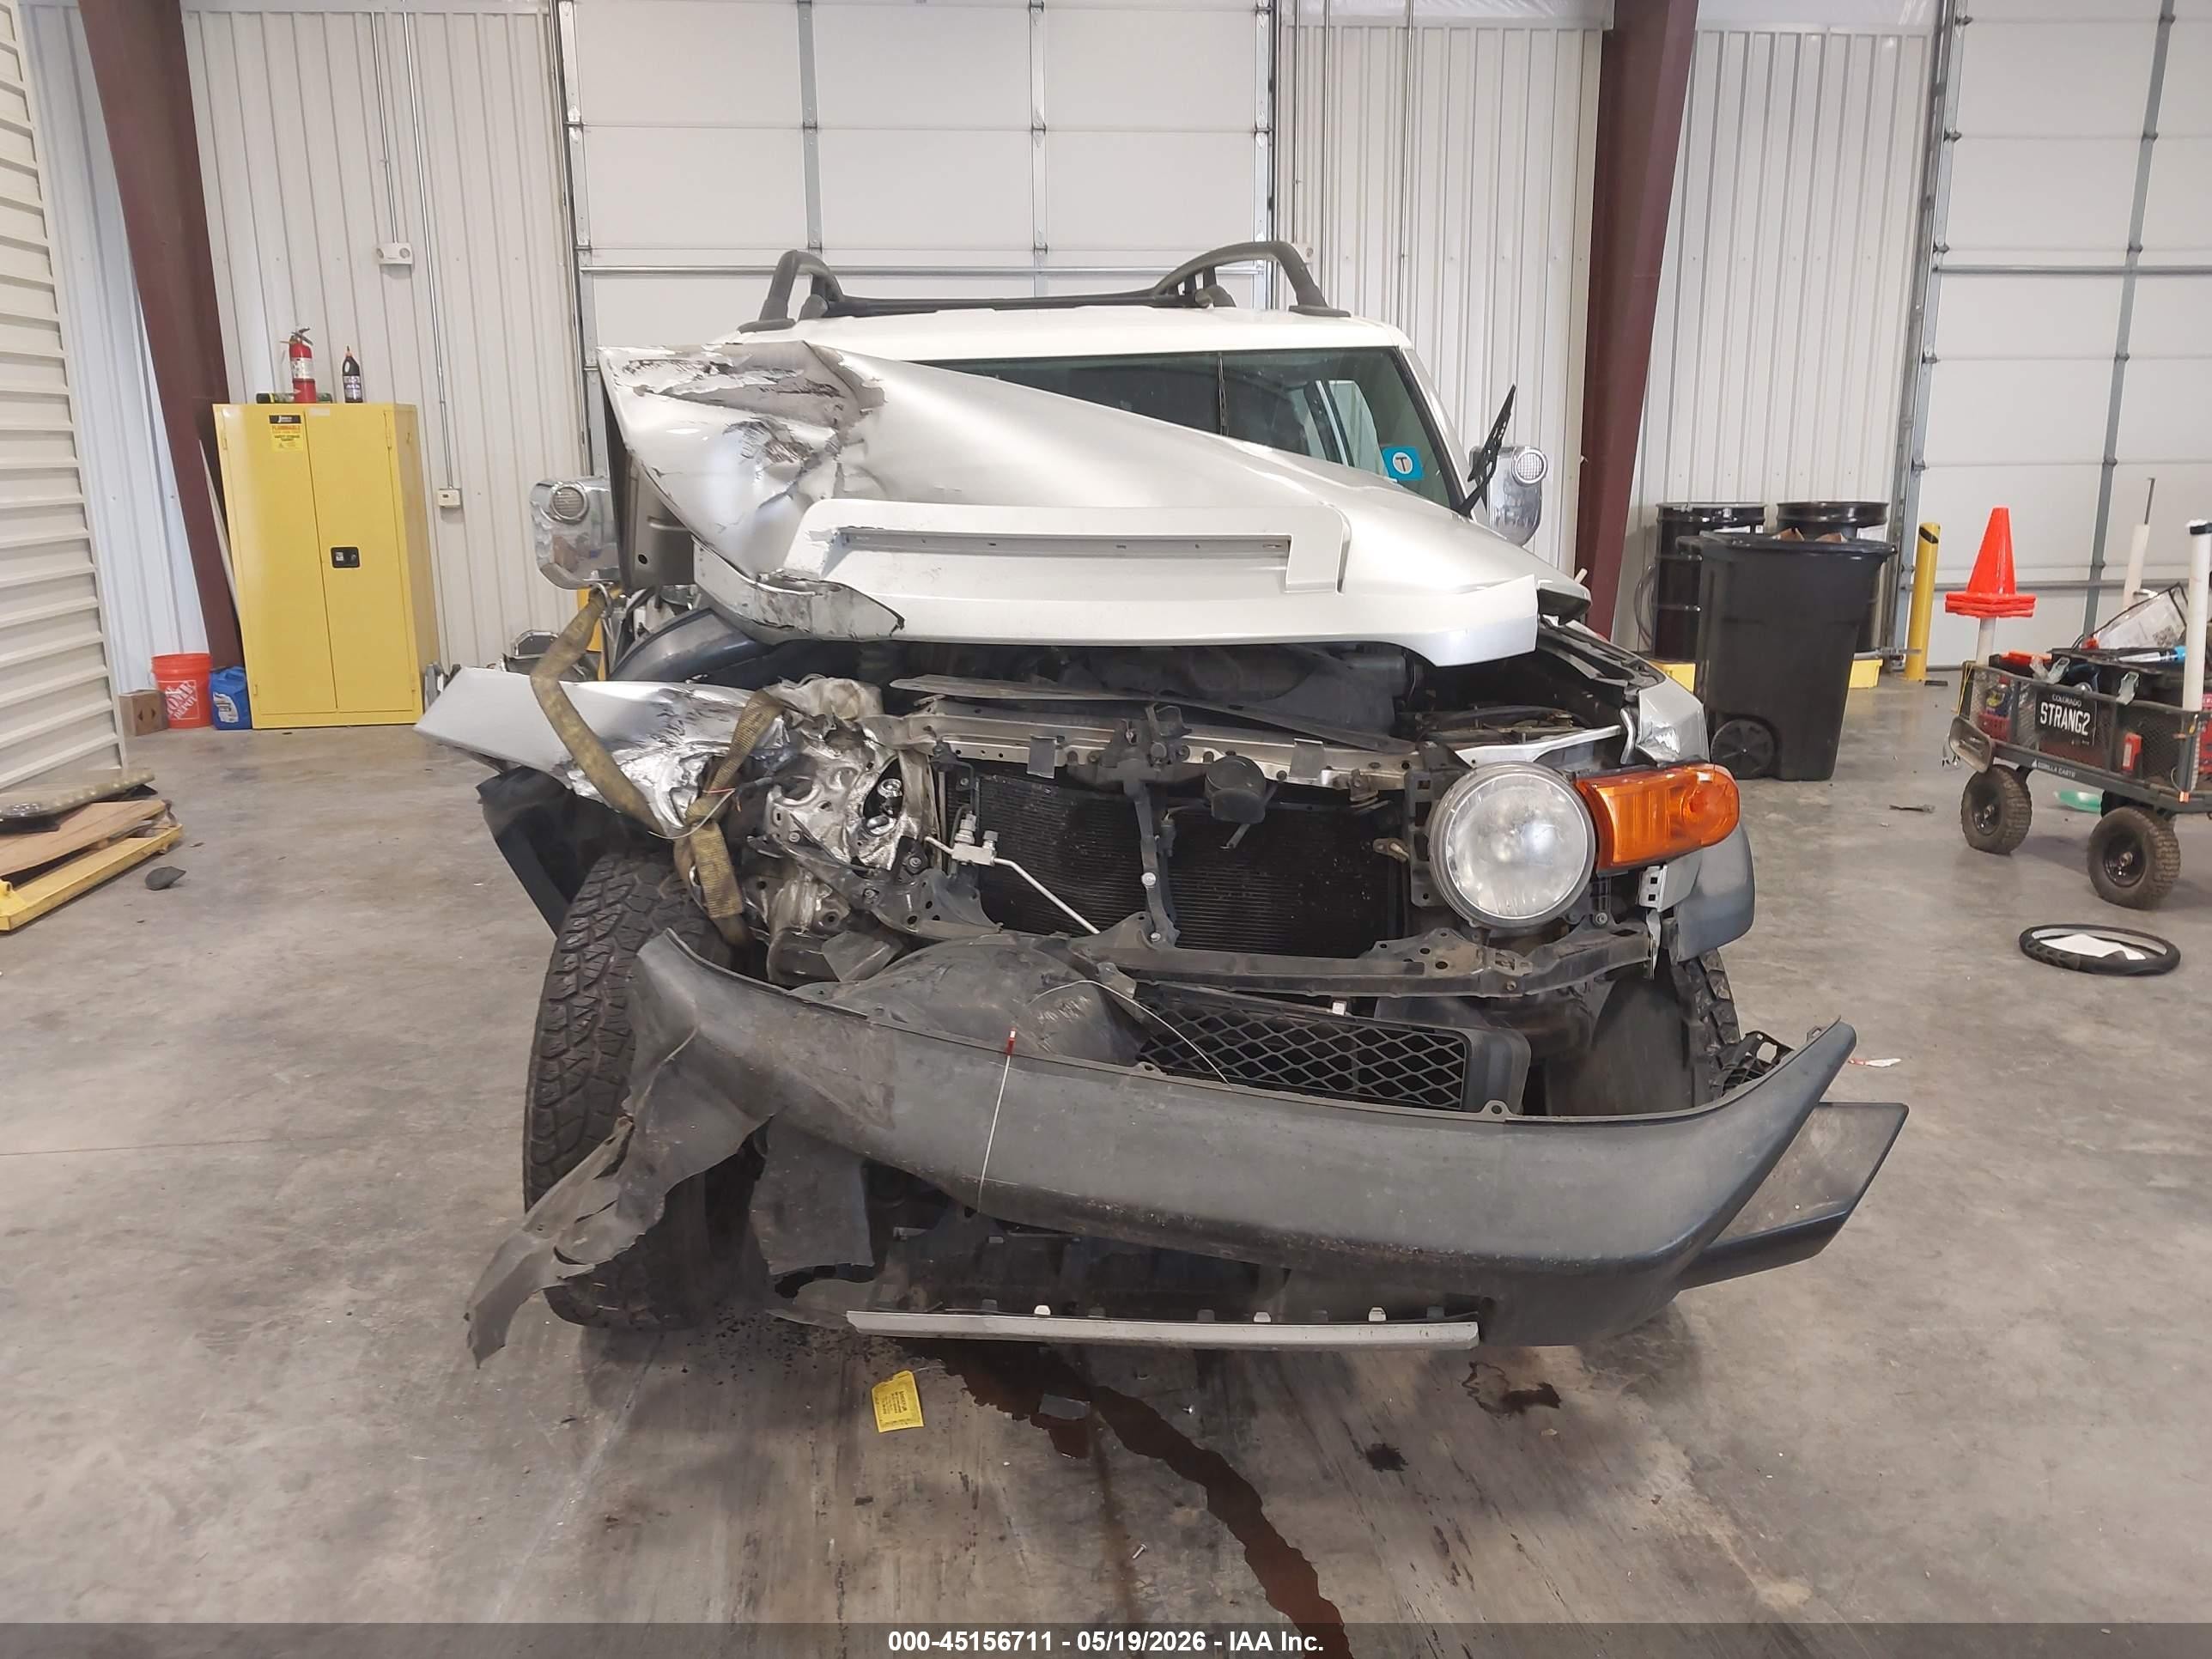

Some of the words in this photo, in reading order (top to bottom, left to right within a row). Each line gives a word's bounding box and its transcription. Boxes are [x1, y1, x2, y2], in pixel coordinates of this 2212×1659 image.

[1395, 457, 1407, 471] T
[2052, 694, 2082, 708] COLORADO
[2040, 702, 2091, 736] STRANG2
